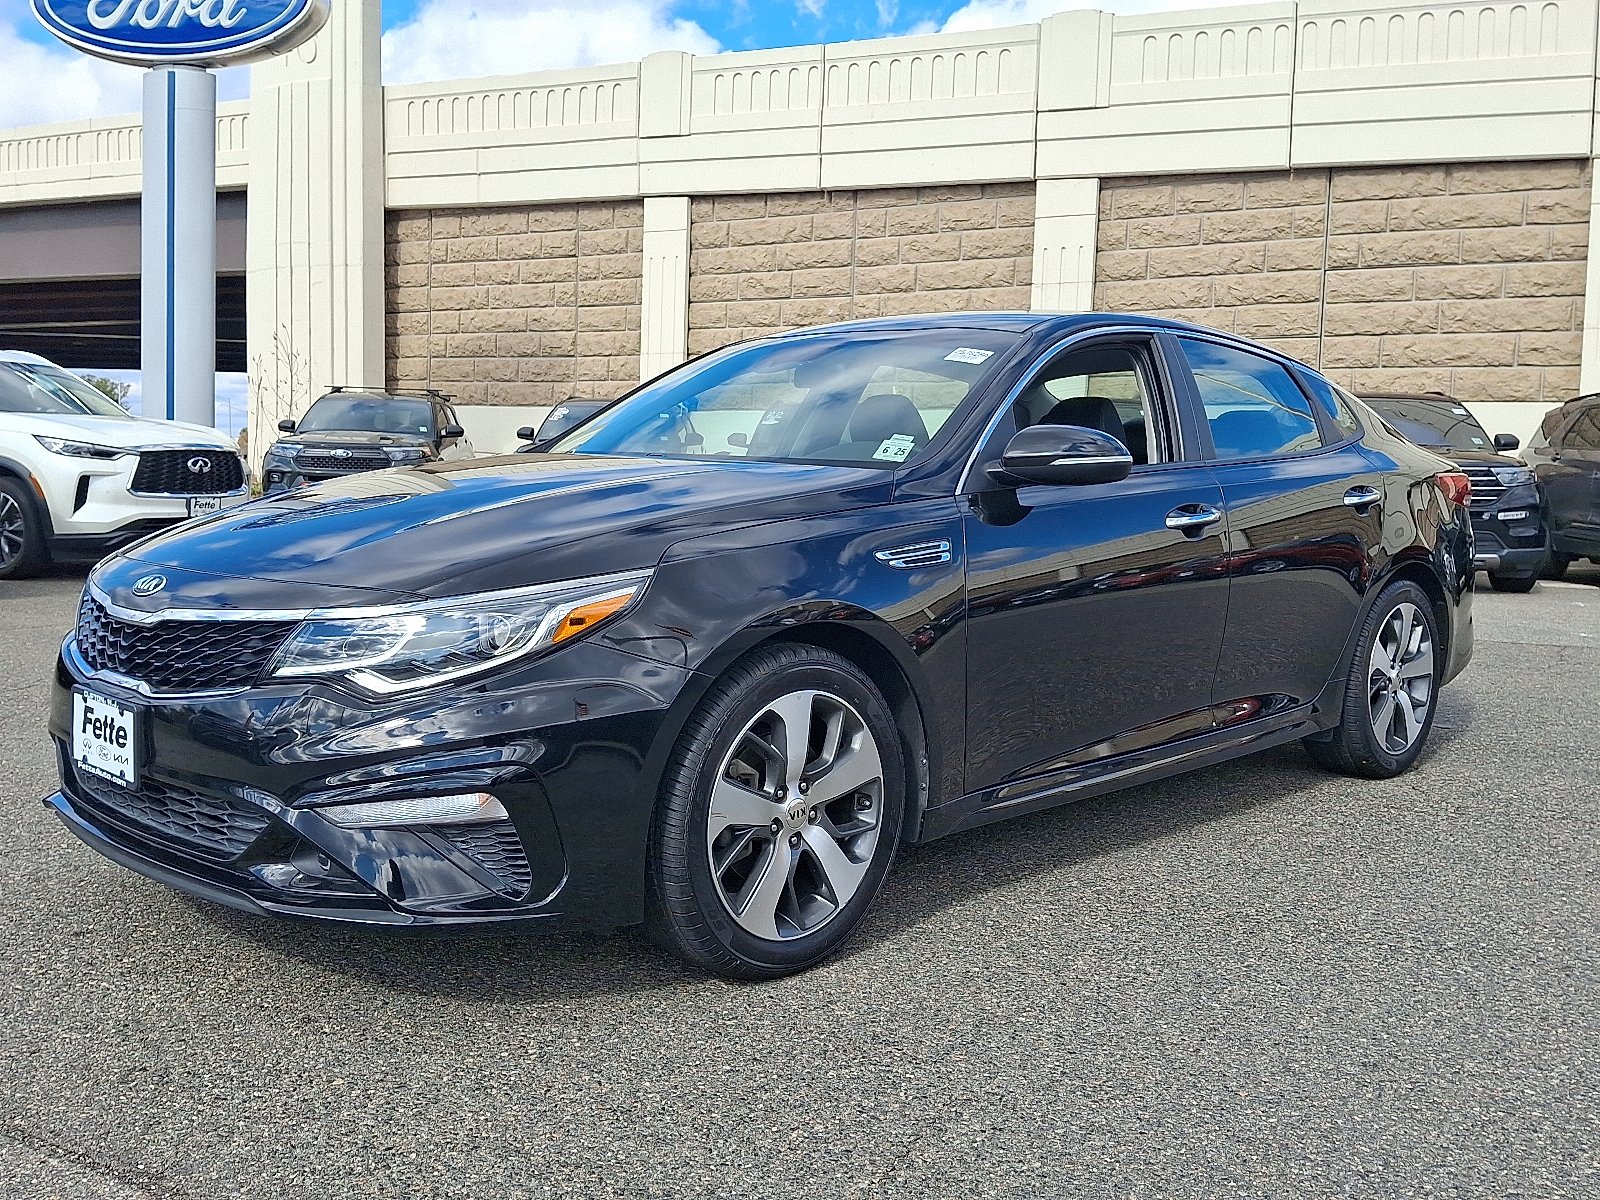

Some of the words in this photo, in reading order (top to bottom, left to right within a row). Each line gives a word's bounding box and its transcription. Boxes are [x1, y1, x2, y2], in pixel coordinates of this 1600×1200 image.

[894, 447, 907, 456] 25
[194, 500, 216, 509] Fette
[82, 705, 127, 748] Fette
[789, 807, 806, 820] KIA
